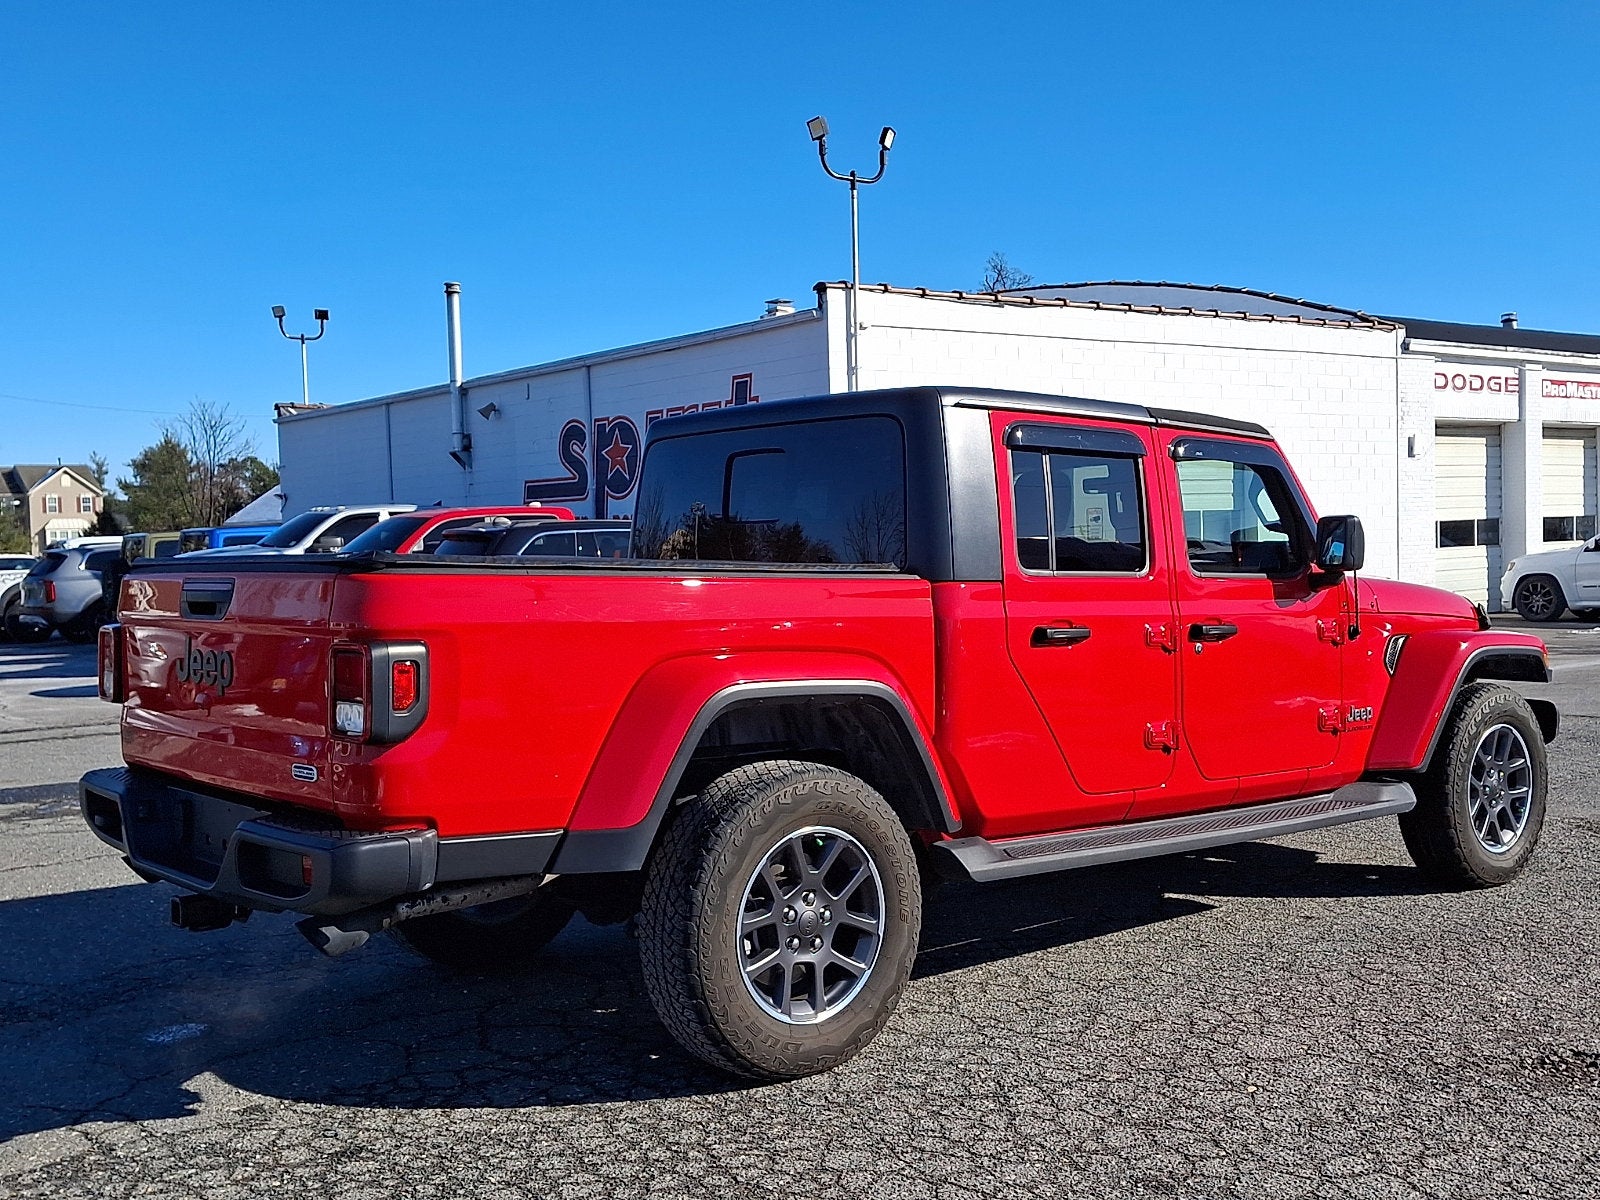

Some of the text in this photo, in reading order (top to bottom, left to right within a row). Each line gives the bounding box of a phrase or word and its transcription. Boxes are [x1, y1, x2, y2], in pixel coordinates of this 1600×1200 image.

[1434, 372, 1519, 394] DODGE
[176, 634, 234, 696] Jeep
[1346, 705, 1374, 722] Jeep
[813, 799, 911, 926] BRIDGESTONE
